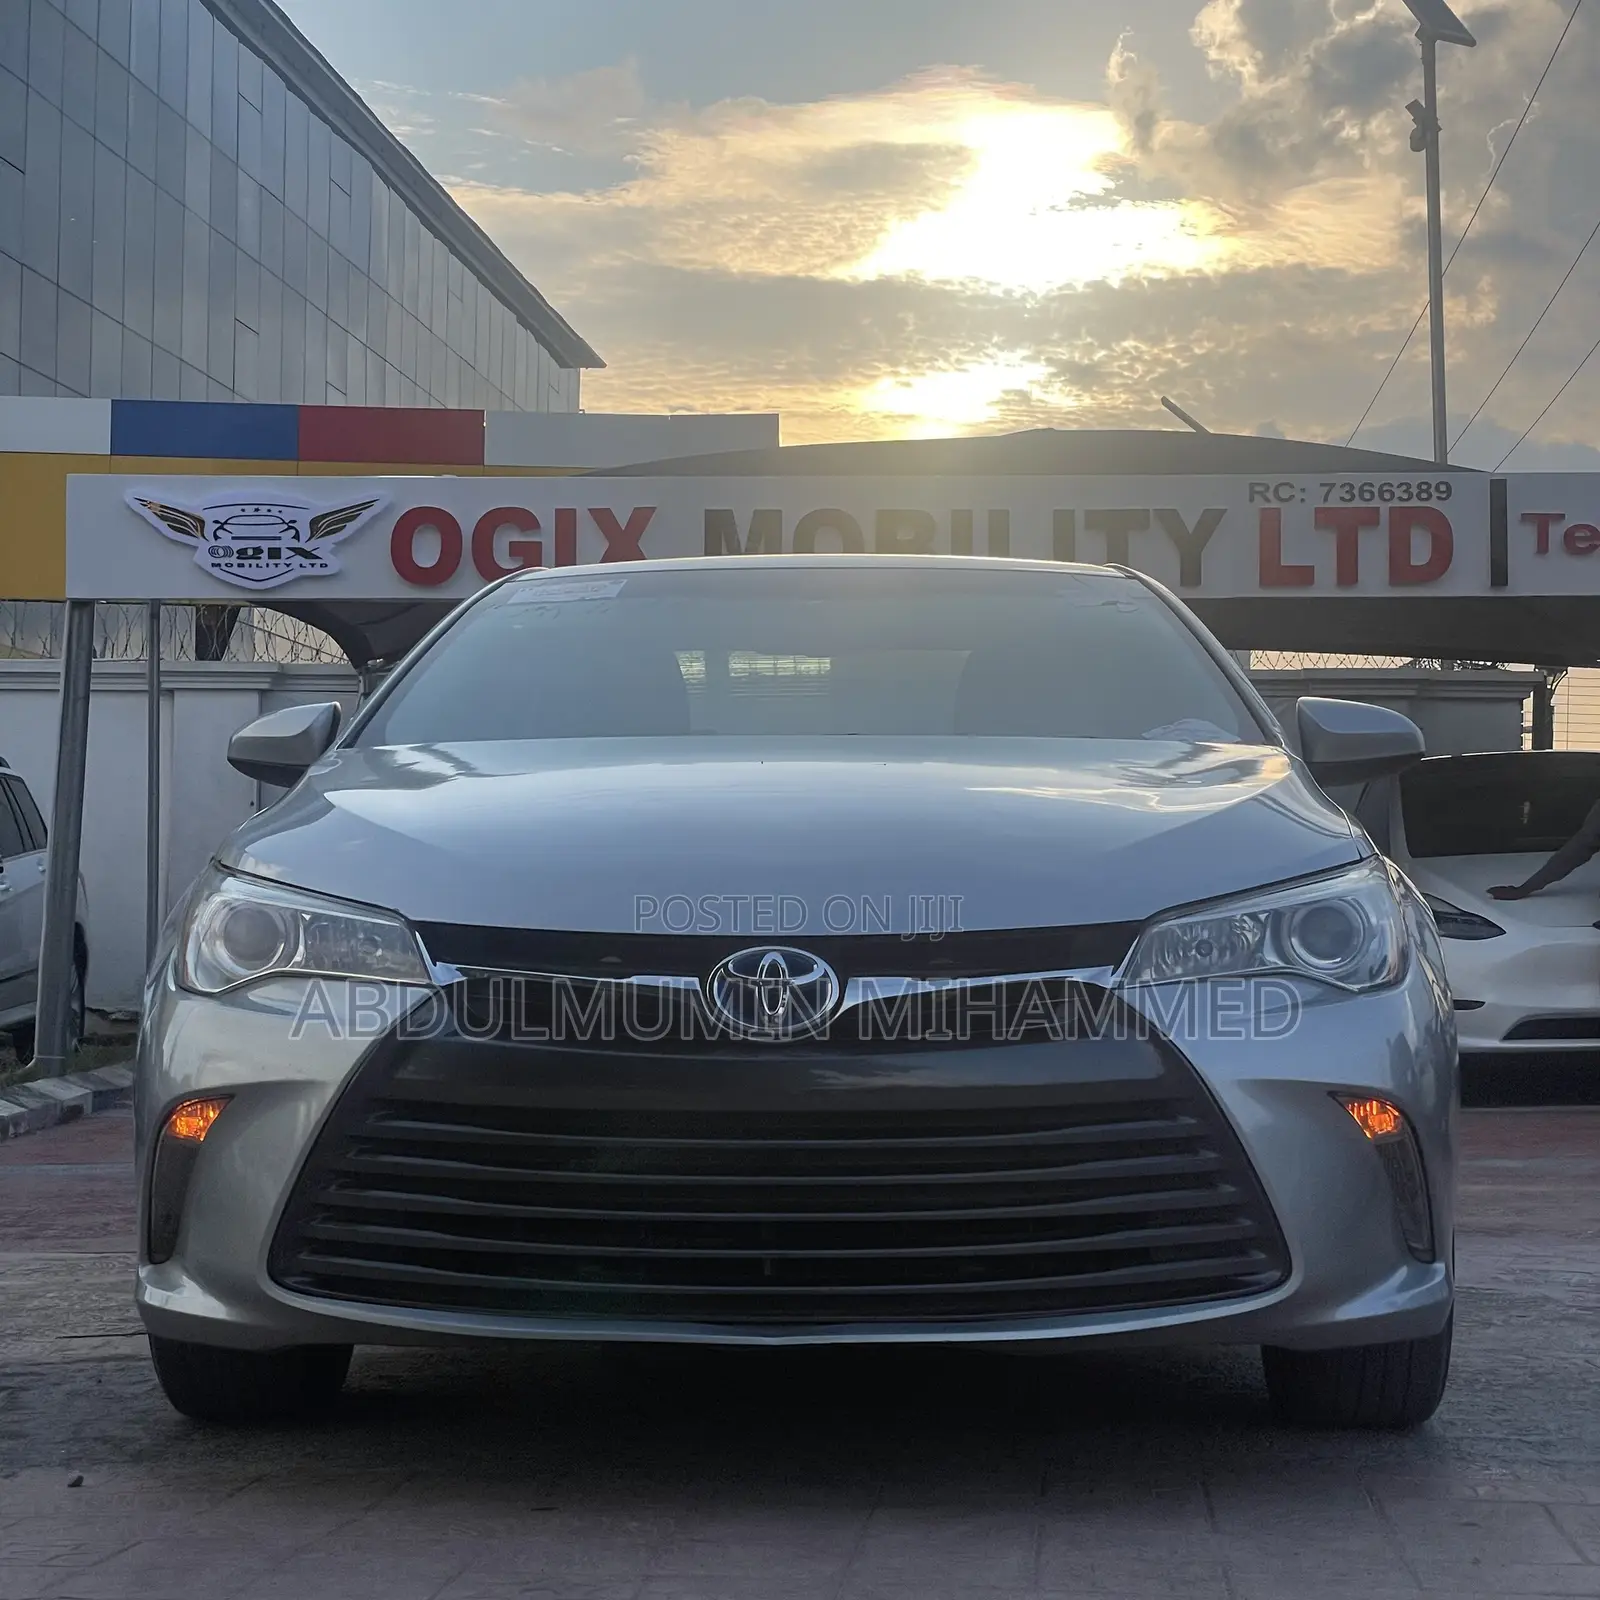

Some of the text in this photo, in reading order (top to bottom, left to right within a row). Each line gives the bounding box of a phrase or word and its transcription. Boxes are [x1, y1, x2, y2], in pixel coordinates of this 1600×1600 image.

[1249, 481, 1453, 503] RC: 7366389
[391, 505, 657, 585] OGIX
[1259, 506, 1454, 587] LTD
